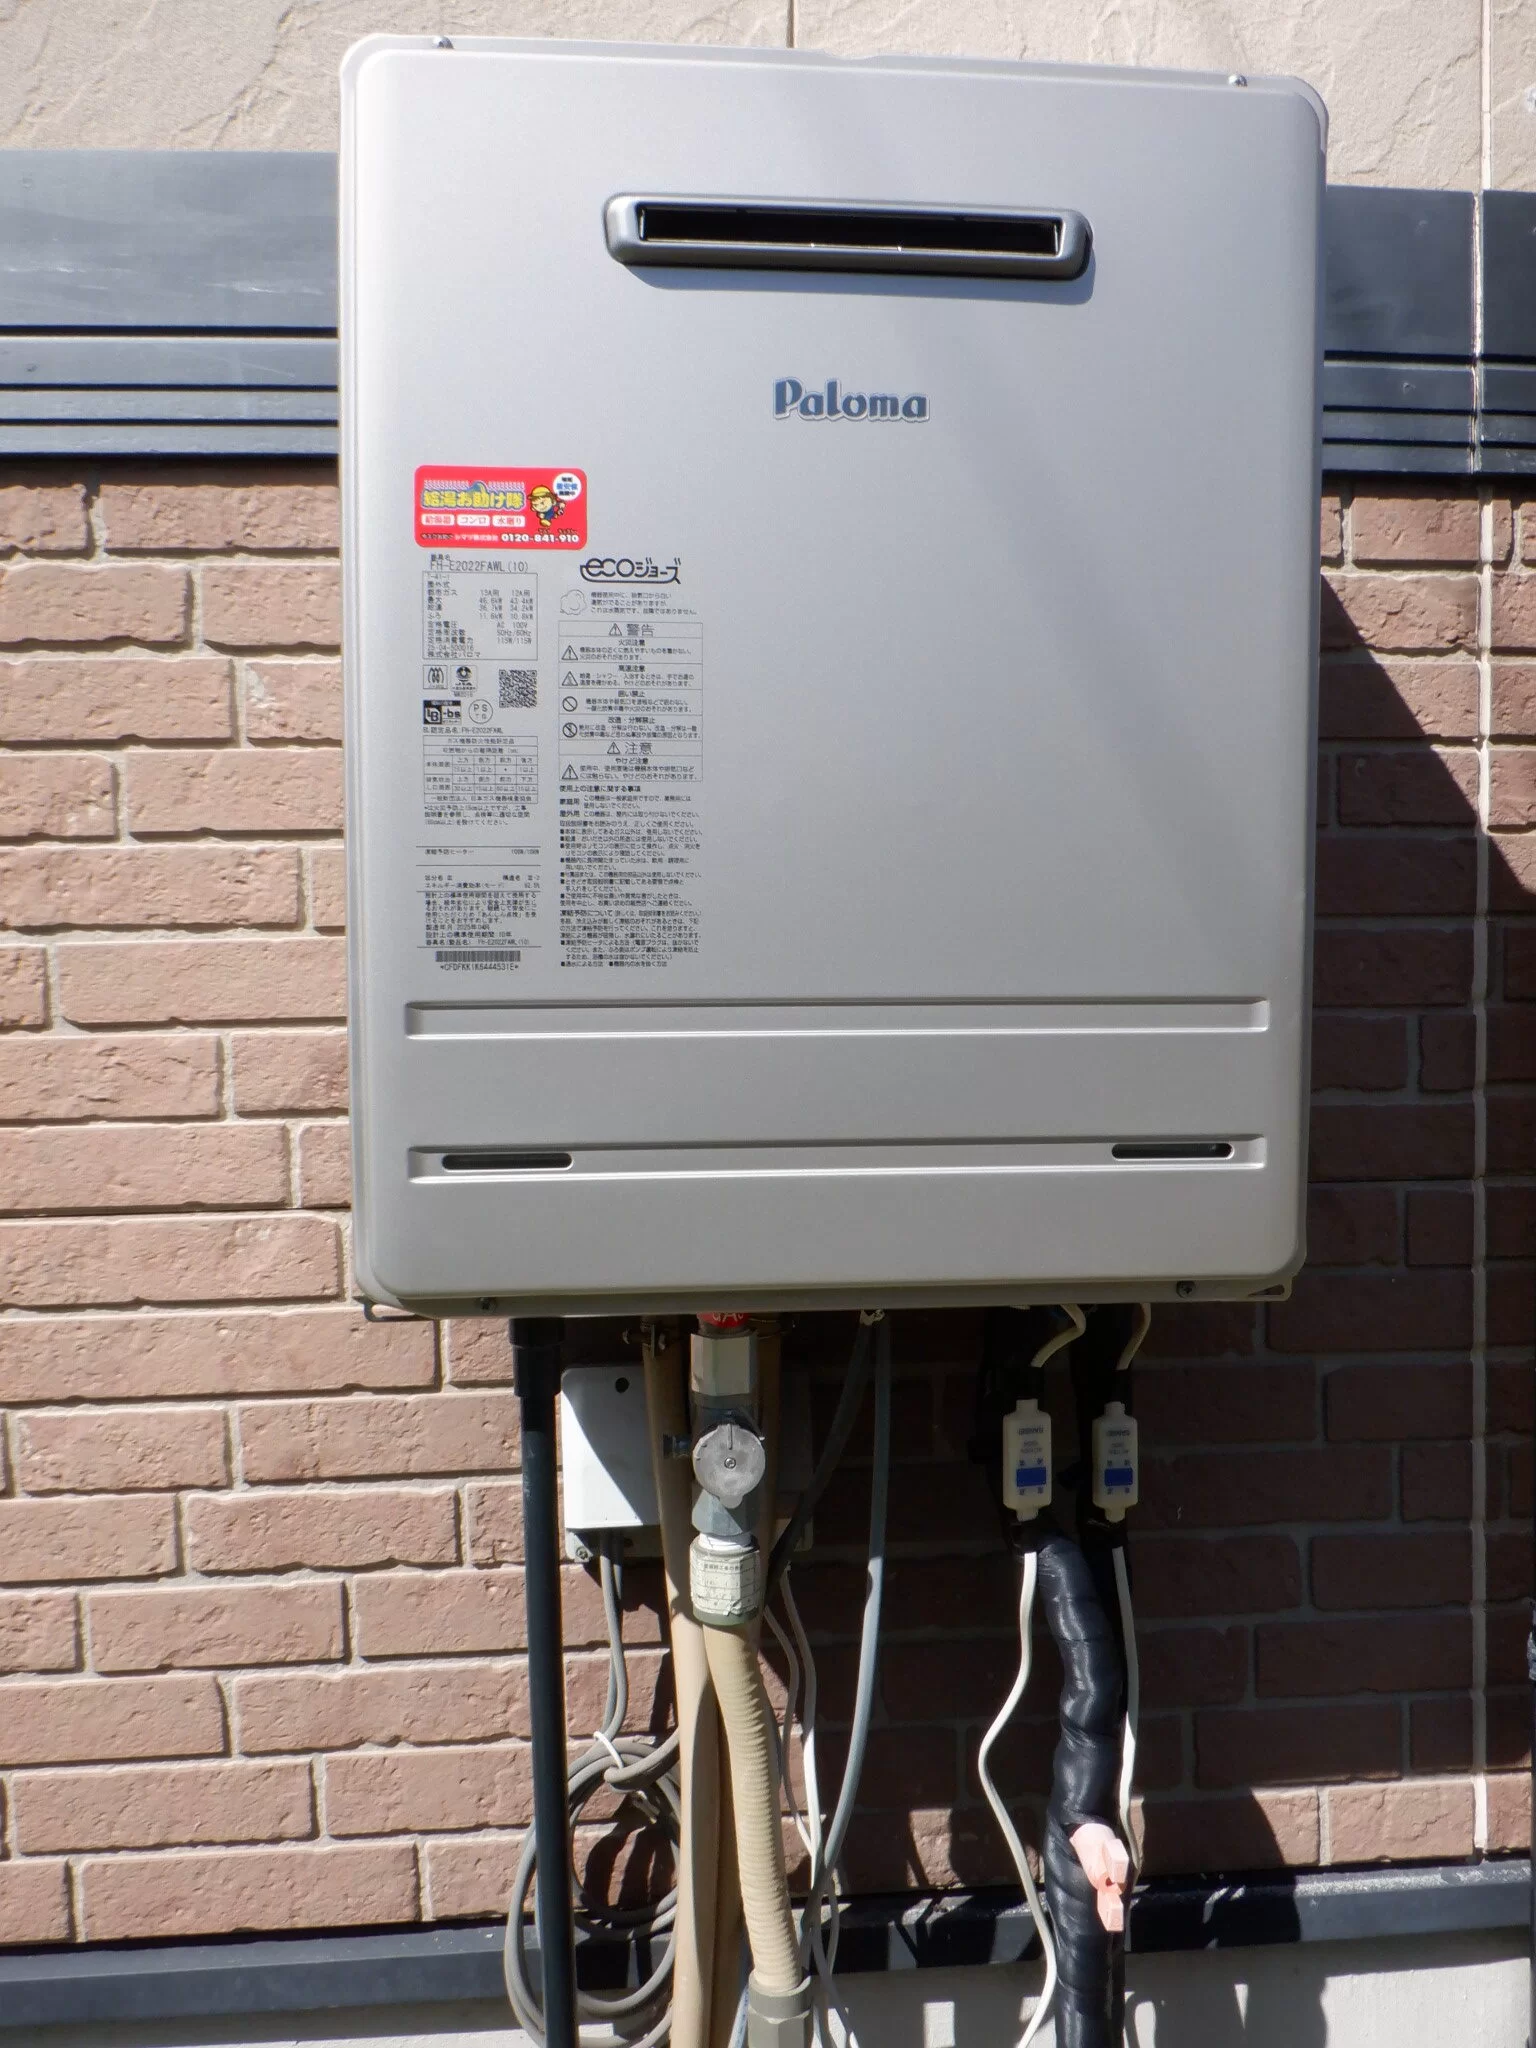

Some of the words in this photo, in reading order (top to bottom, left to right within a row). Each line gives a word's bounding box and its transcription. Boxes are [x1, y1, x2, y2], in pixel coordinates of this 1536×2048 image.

[774, 378, 929, 419] Paloma
[460, 516, 487, 524] コンロ
[501, 534, 579, 543] 0120-841-910
[430, 560, 529, 572] FH-E2022FAWL(10)
